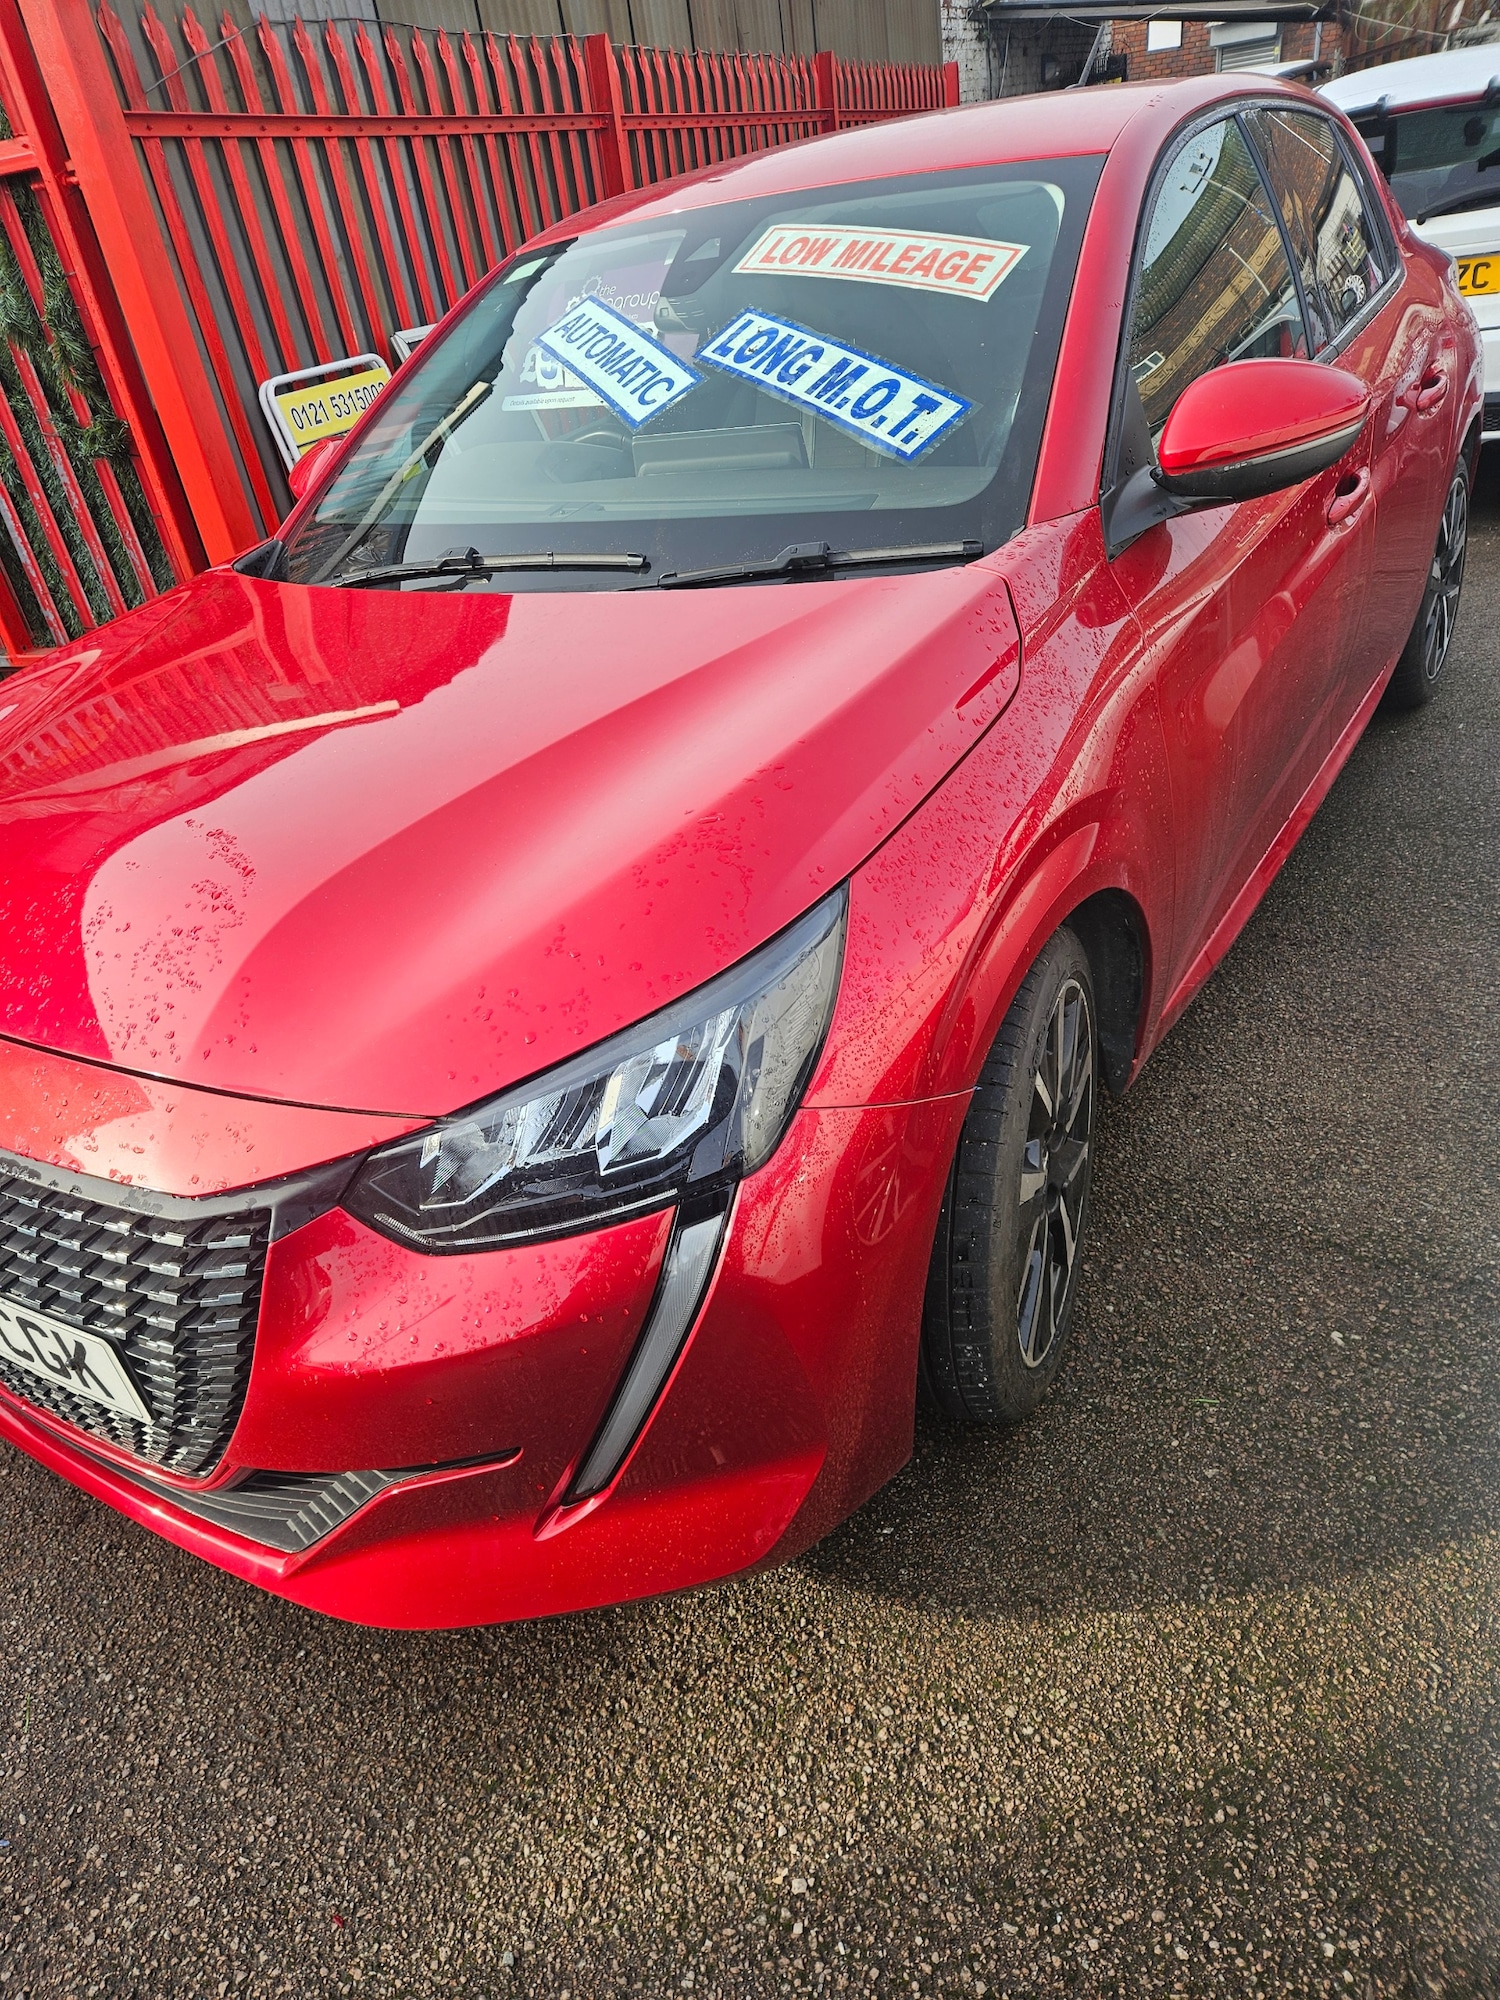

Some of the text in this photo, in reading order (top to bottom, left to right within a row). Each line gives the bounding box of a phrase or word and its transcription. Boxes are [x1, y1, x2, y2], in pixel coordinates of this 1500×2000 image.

[759, 236, 996, 285] LOW MILEAGE
[600, 284, 617, 297] the
[553, 312, 675, 406] AUTOMATIC
[711, 319, 943, 445] LONG M.O.T.
[291, 400, 330, 430] 0121
